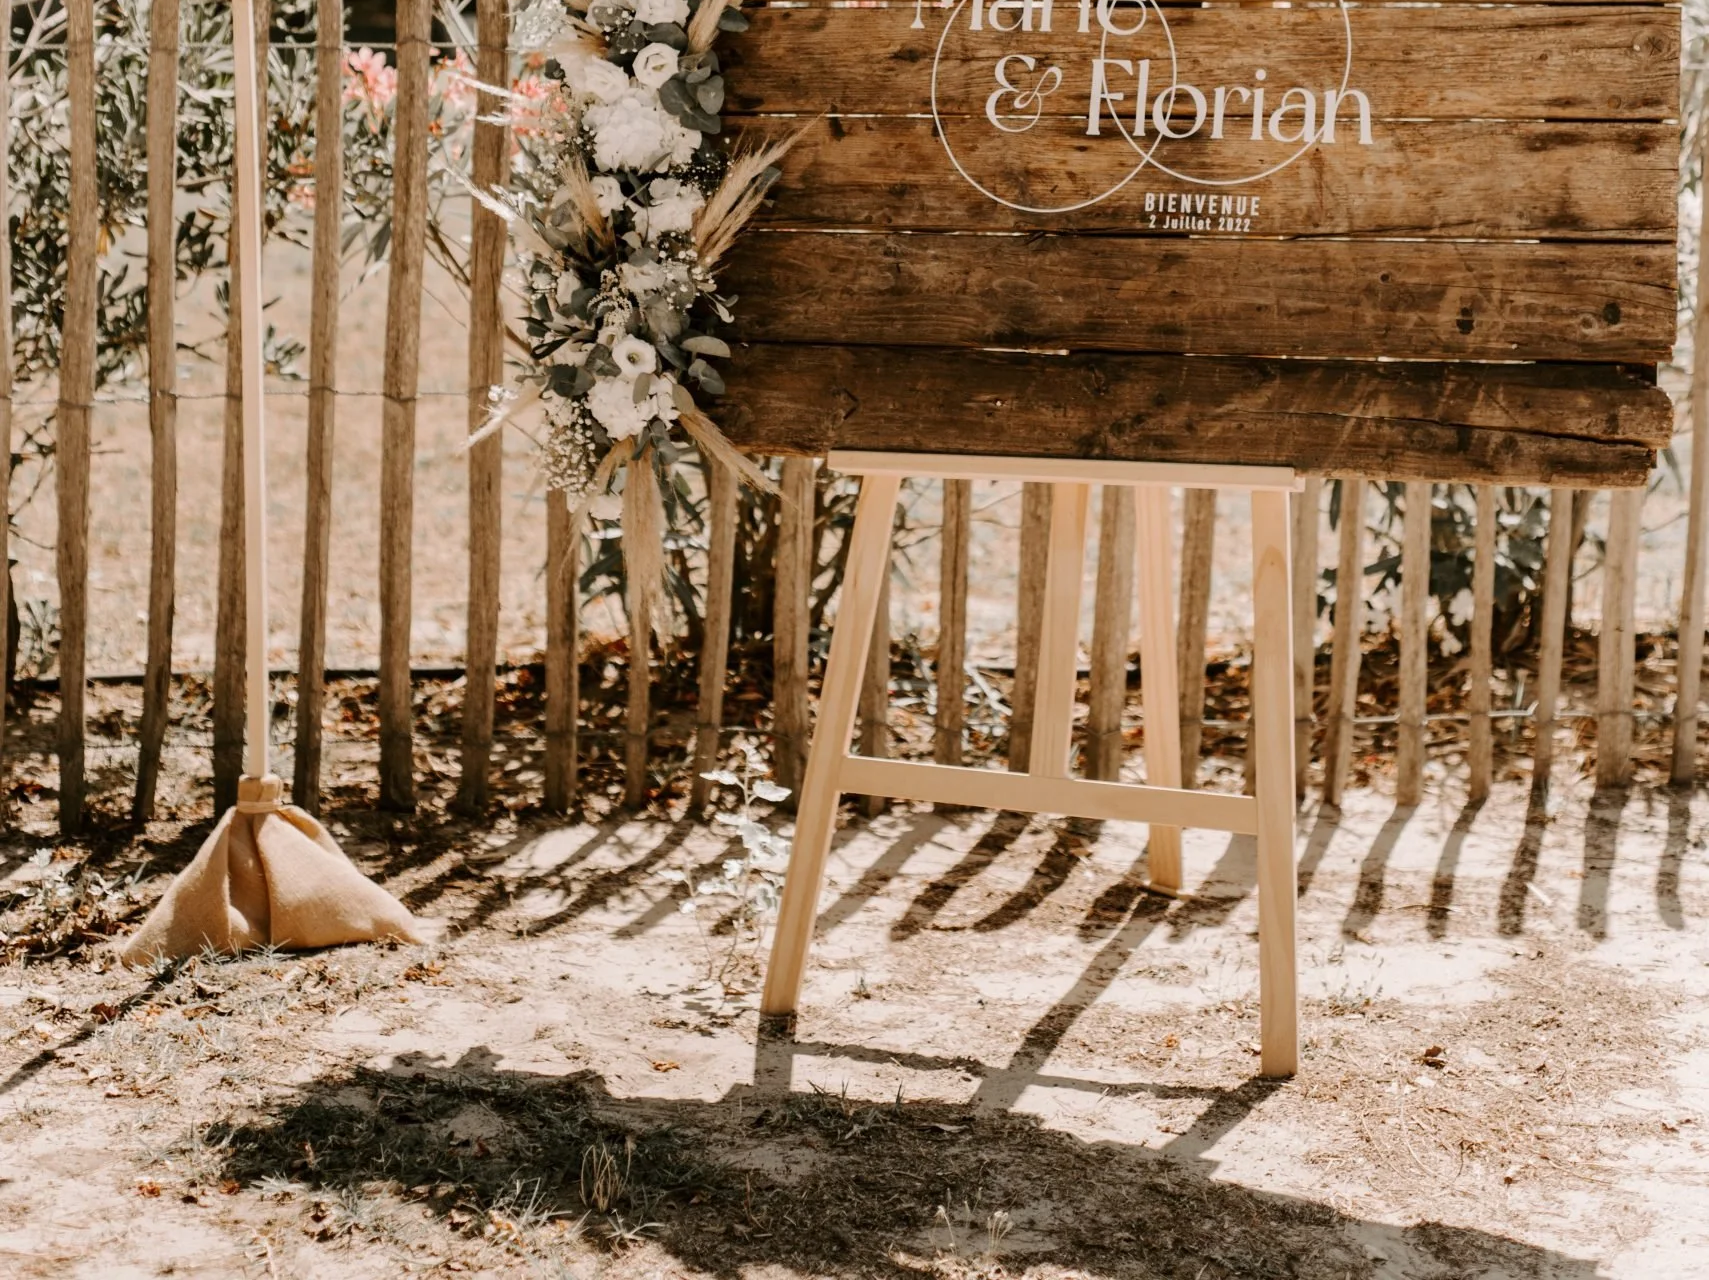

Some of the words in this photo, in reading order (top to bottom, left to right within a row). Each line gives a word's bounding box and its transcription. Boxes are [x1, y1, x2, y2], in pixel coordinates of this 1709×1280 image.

[985, 54, 1063, 133] &
[1086, 58, 1374, 145] Florian
[1144, 192, 1261, 216] BIENVENUE
[1149, 214, 1157, 229] 2
[1163, 215, 1212, 230] Juillet
[1218, 217, 1251, 232] 2022
